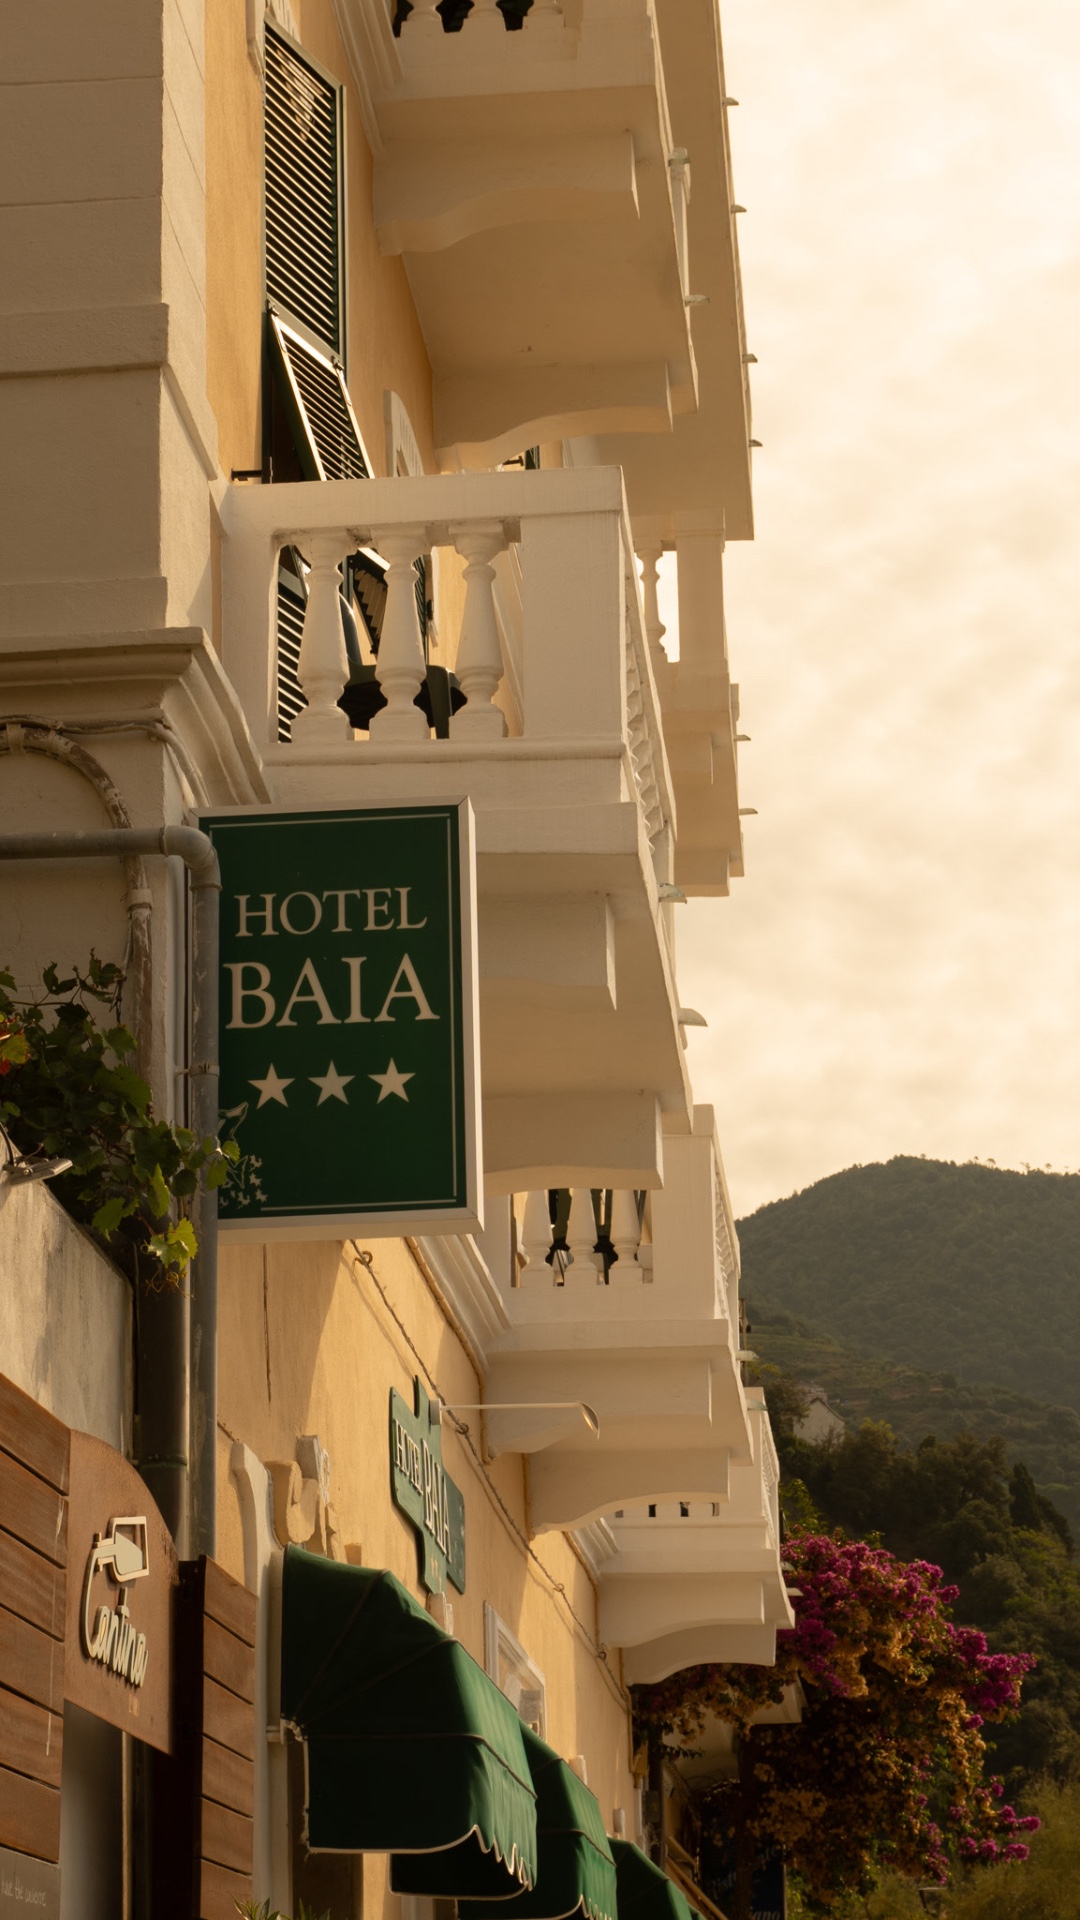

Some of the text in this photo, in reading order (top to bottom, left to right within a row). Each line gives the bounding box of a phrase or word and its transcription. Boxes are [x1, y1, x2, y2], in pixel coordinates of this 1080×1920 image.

[234, 887, 427, 937] HOTEL
[222, 952, 440, 1029] BAIA
[393, 1417, 424, 1496] HOTEL
[420, 1438, 453, 1564] BAIA
[84, 1546, 149, 1688] Cantina
